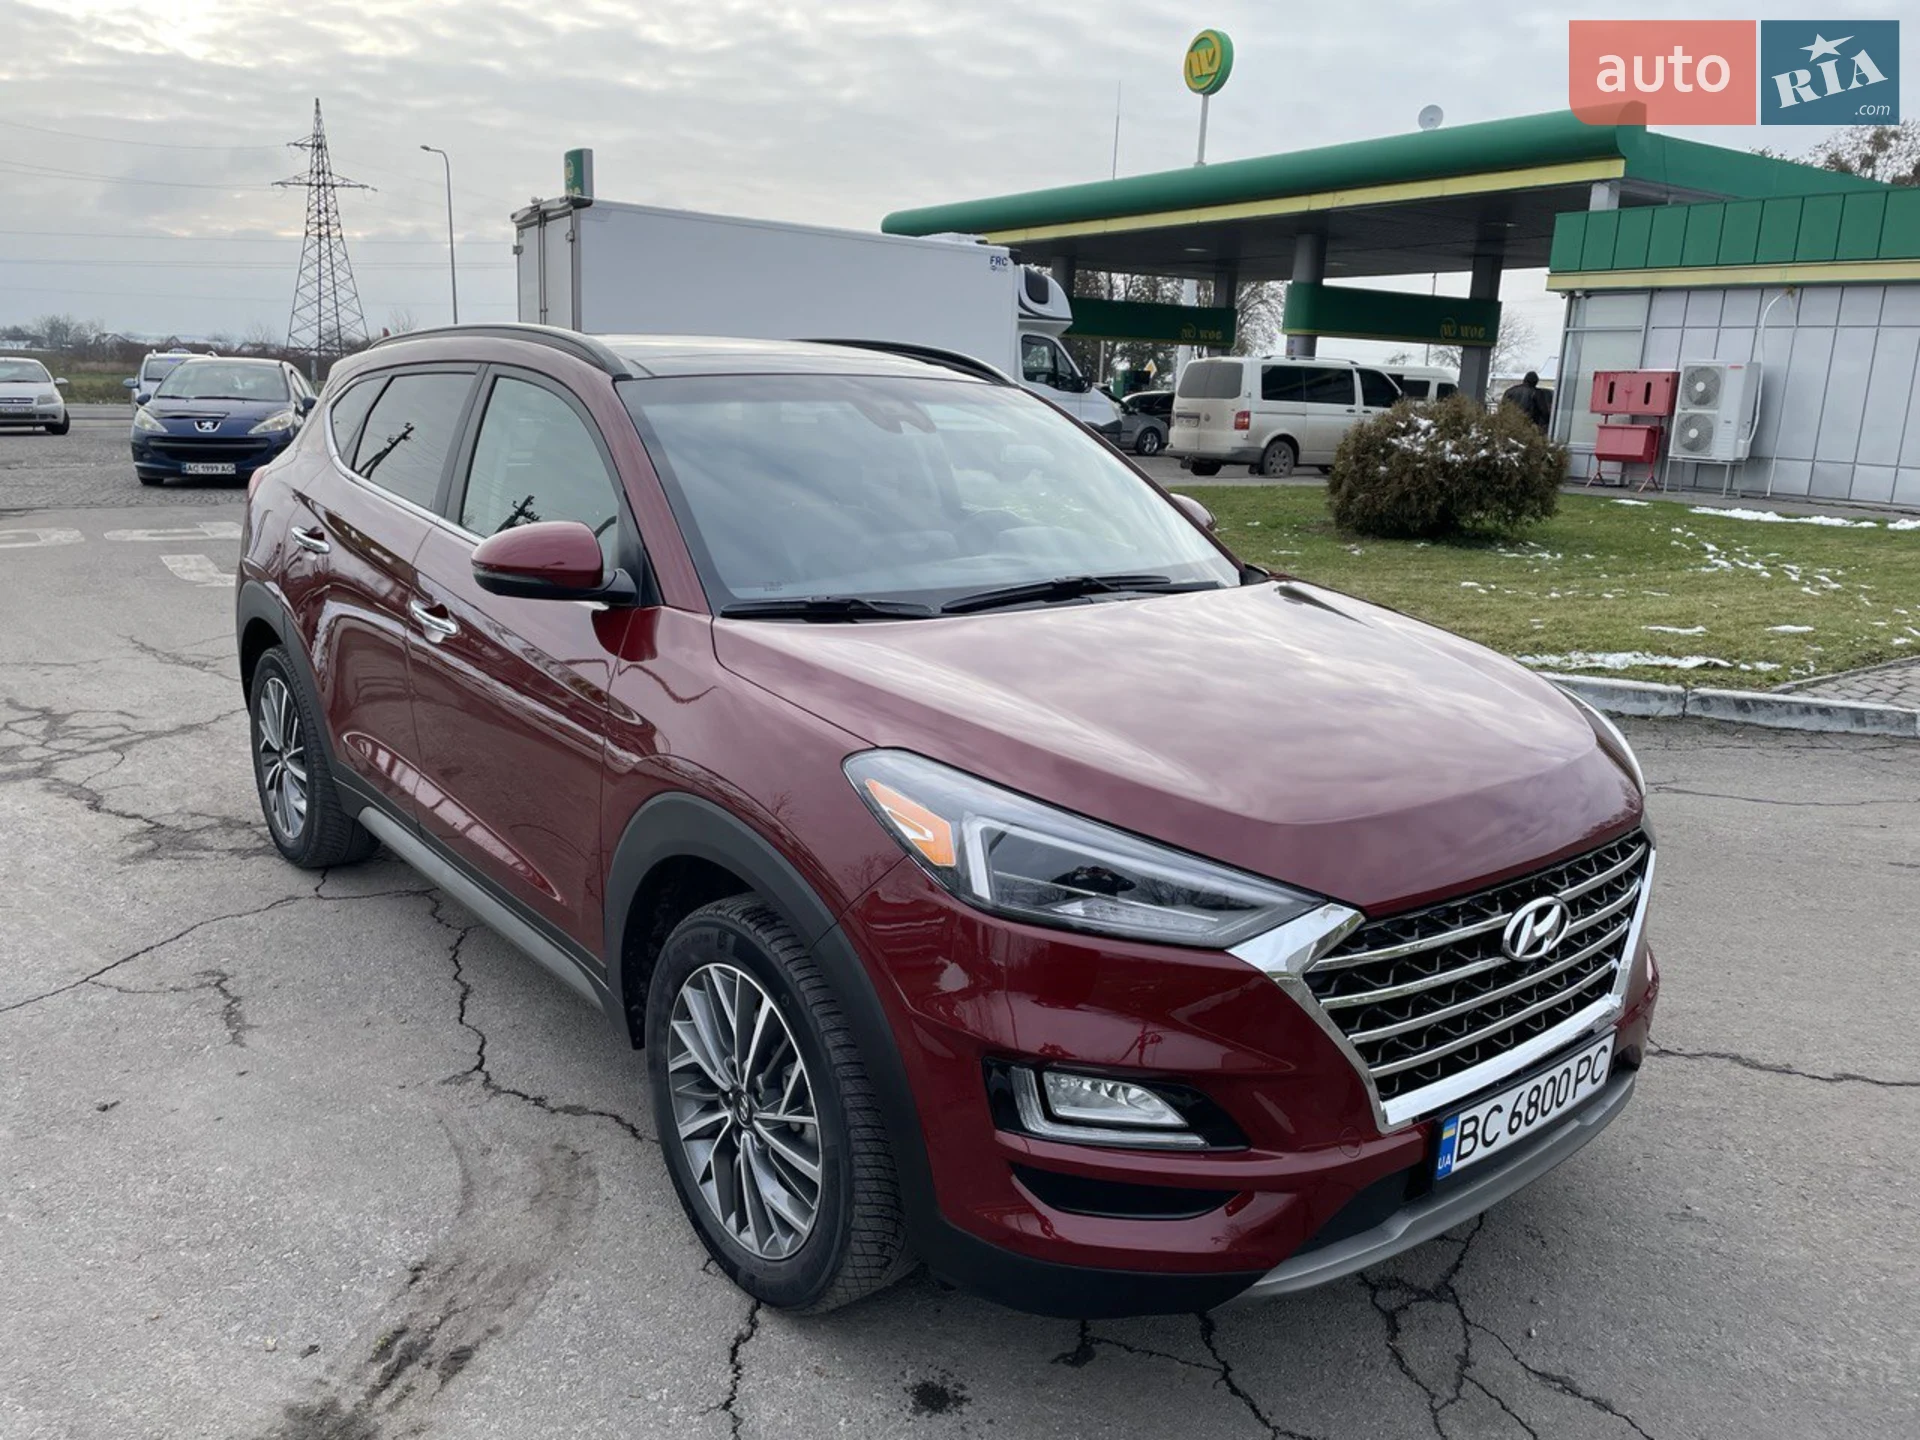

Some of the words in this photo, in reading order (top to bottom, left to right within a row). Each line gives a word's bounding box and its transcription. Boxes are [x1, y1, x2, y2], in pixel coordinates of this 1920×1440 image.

[990, 255, 1008, 266] FRC
[1455, 1103, 1503, 1163] BC
[1507, 1066, 1571, 1136] 6800
[1572, 1044, 1608, 1100] PC
[1437, 1157, 1451, 1170] UA
